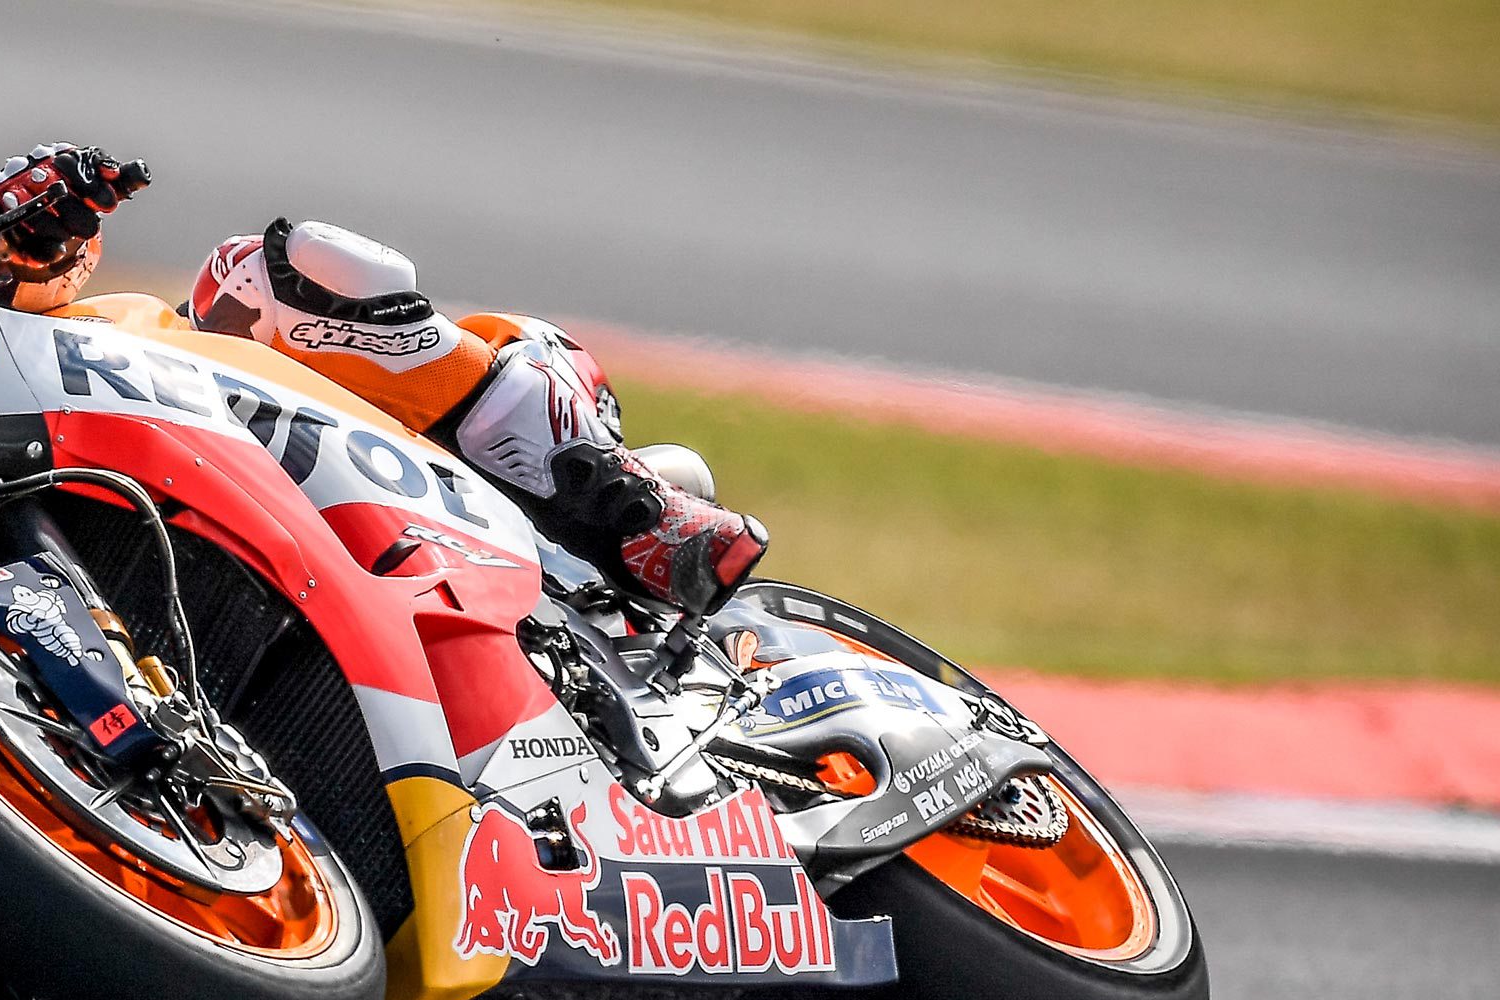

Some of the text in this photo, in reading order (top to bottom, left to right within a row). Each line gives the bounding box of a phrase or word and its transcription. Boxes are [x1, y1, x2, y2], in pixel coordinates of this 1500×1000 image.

[289, 319, 441, 357] alpinestars
[508, 736, 595, 759] HONDA
[953, 758, 989, 796] NGK
[912, 780, 955, 821] RK
[609, 783, 694, 857] Satu
[860, 811, 909, 844] Snap-on
[623, 869, 833, 973] Red Bull
